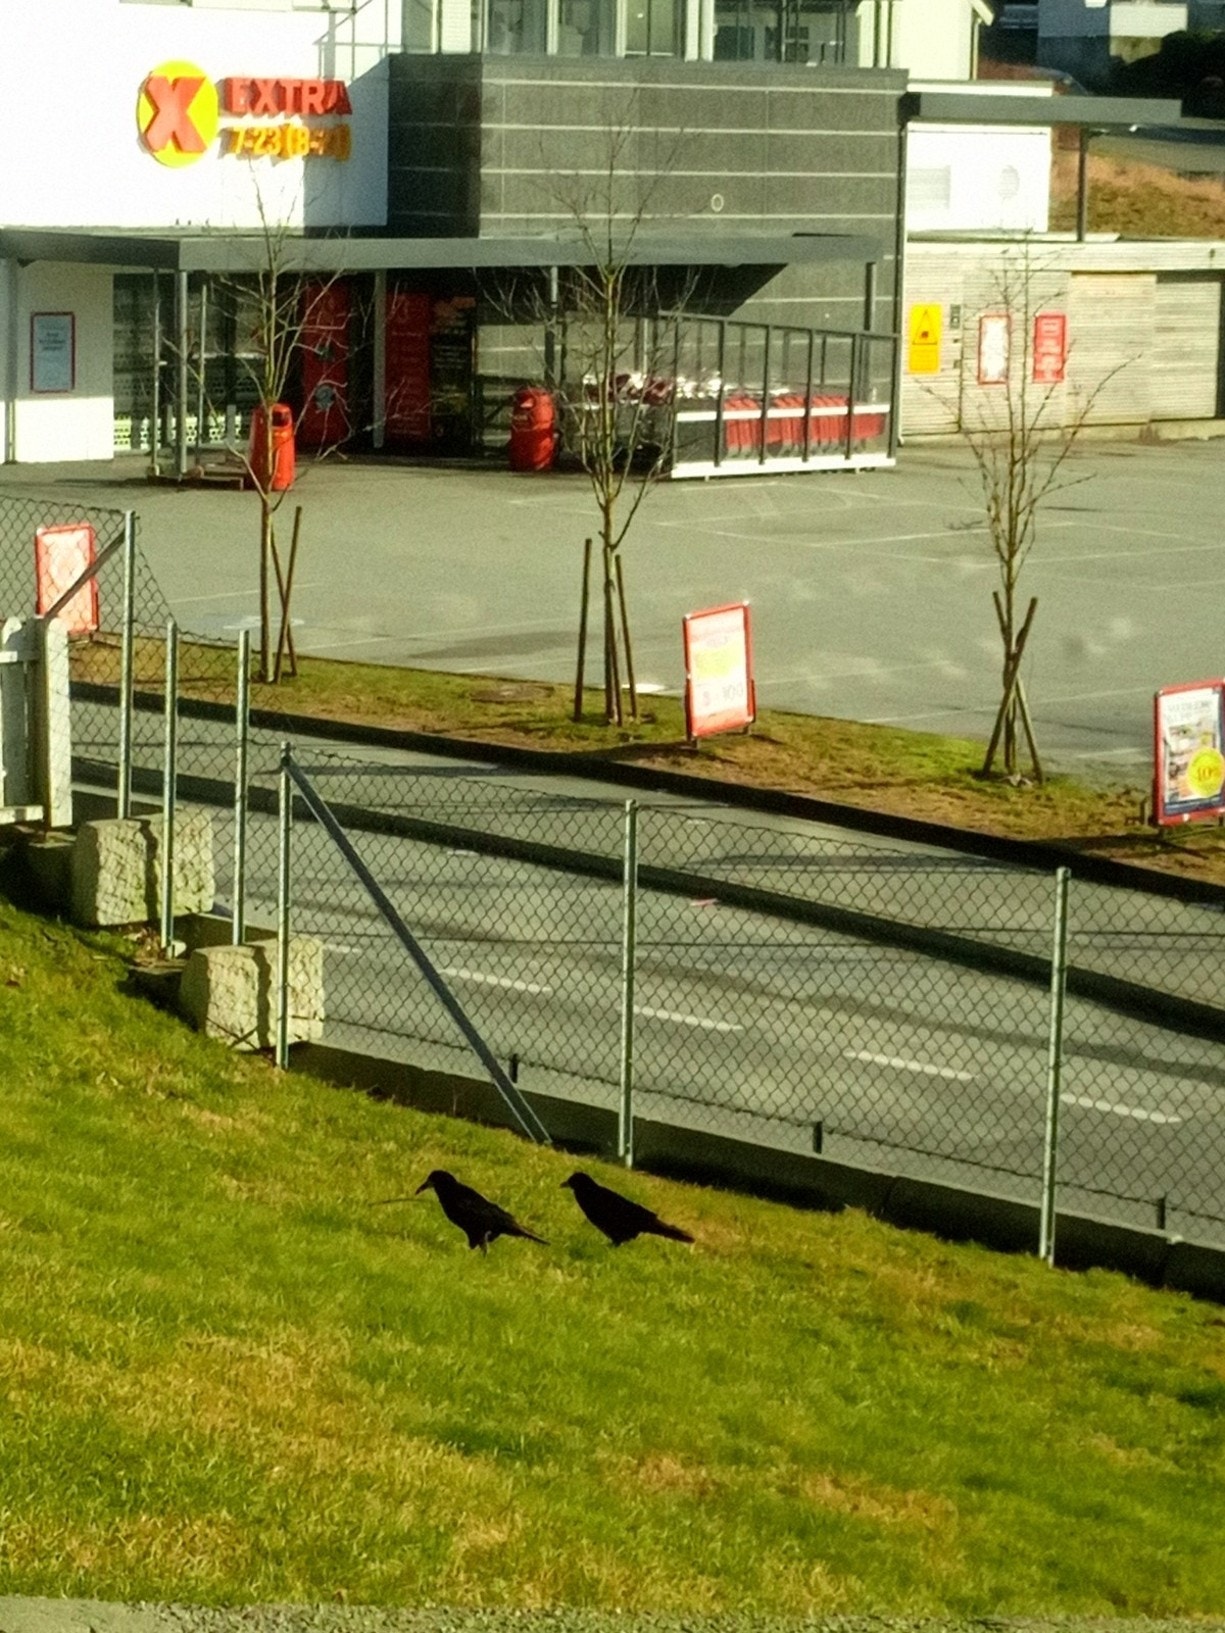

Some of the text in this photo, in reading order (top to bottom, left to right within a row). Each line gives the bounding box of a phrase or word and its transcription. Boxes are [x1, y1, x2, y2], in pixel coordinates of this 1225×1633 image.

[144, 76, 207, 153] X
[226, 77, 352, 115] EXTRA
[231, 127, 281, 156] 7-23
